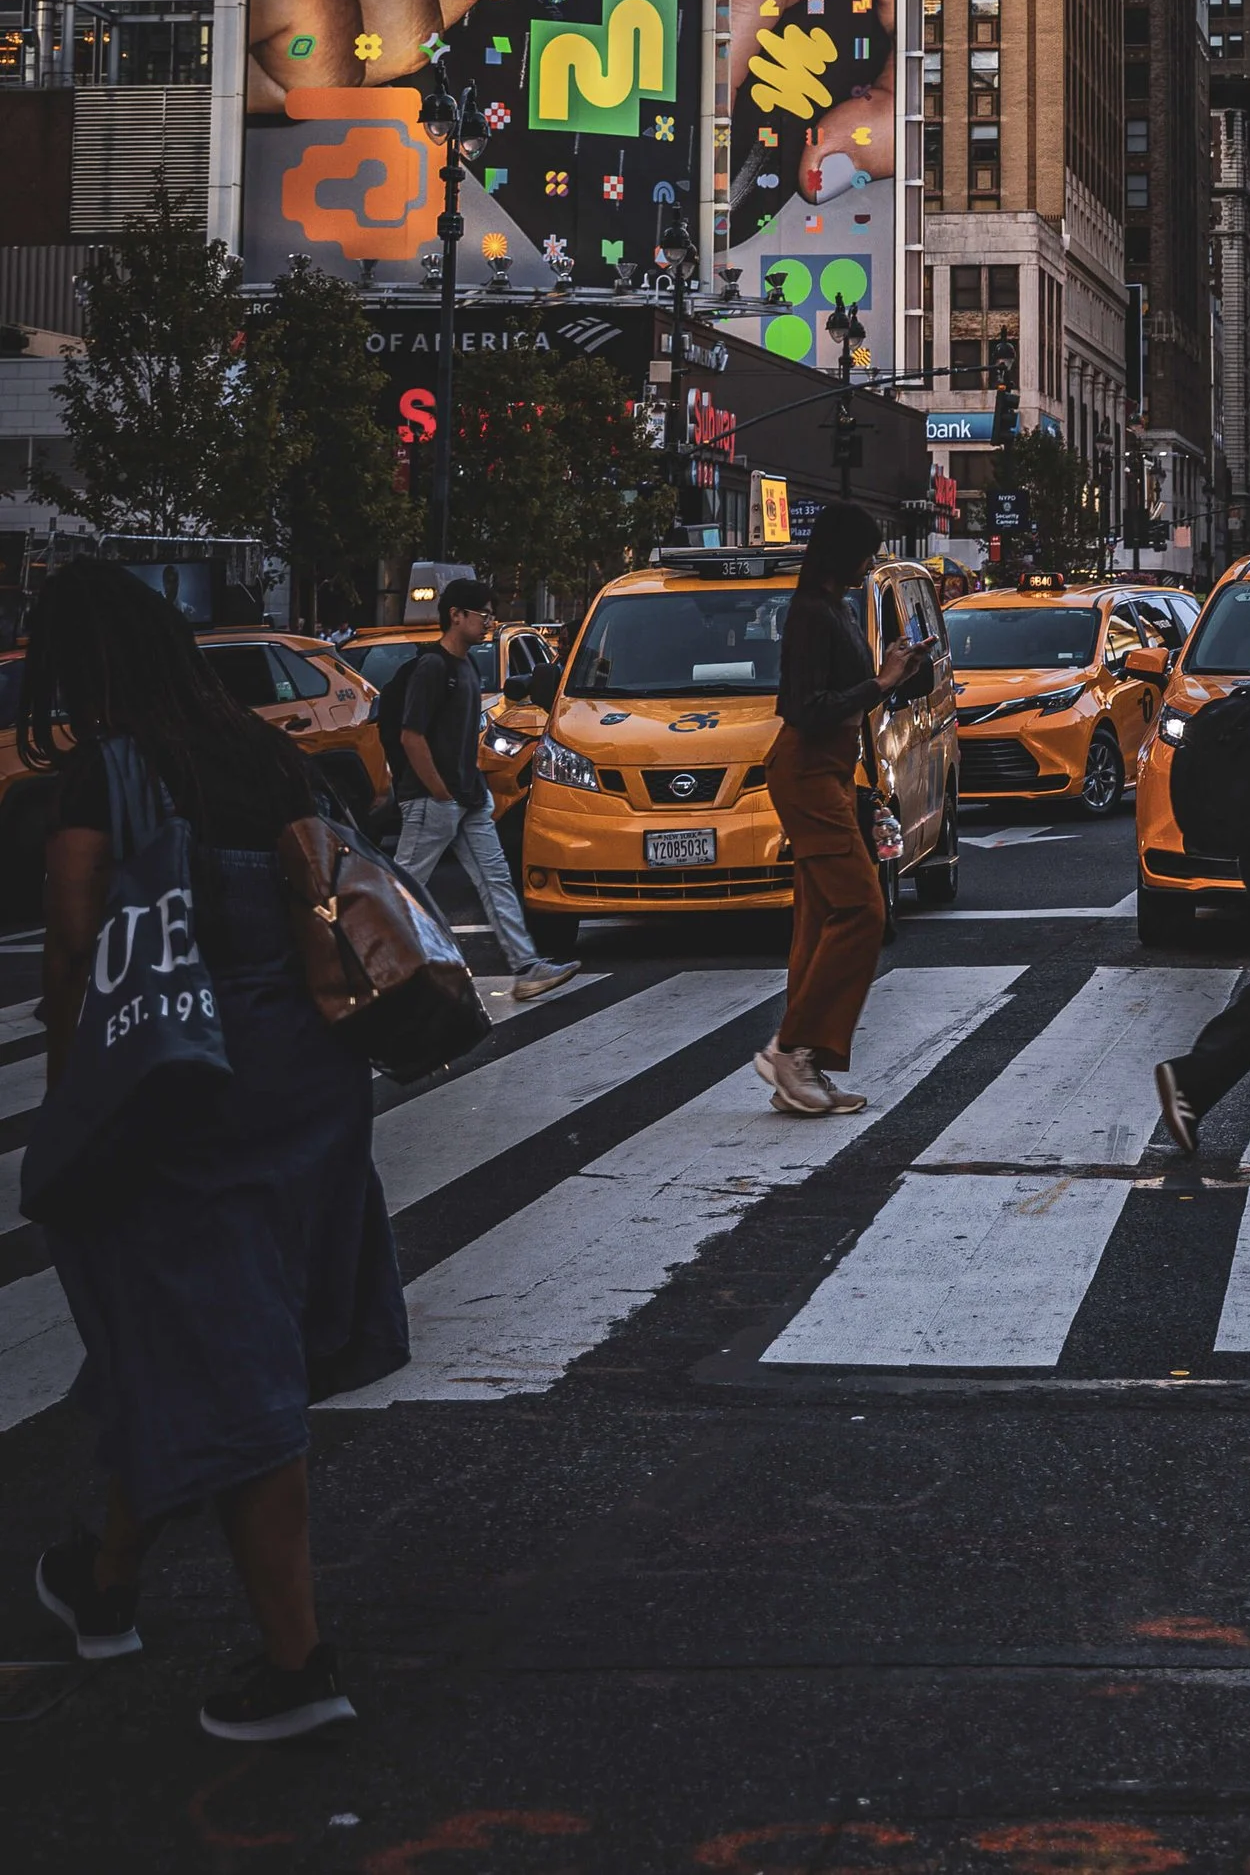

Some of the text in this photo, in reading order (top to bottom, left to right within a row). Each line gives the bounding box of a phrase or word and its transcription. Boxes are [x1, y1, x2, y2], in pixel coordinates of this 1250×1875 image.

[365, 333, 404, 353] OF
[690, 387, 736, 464] Subway
[926, 419, 972, 438] bank
[722, 561, 750, 576] 3E73
[1030, 576, 1052, 587] 6B40
[653, 838, 708, 860] Y208503C
[106, 995, 149, 1047] EST.
